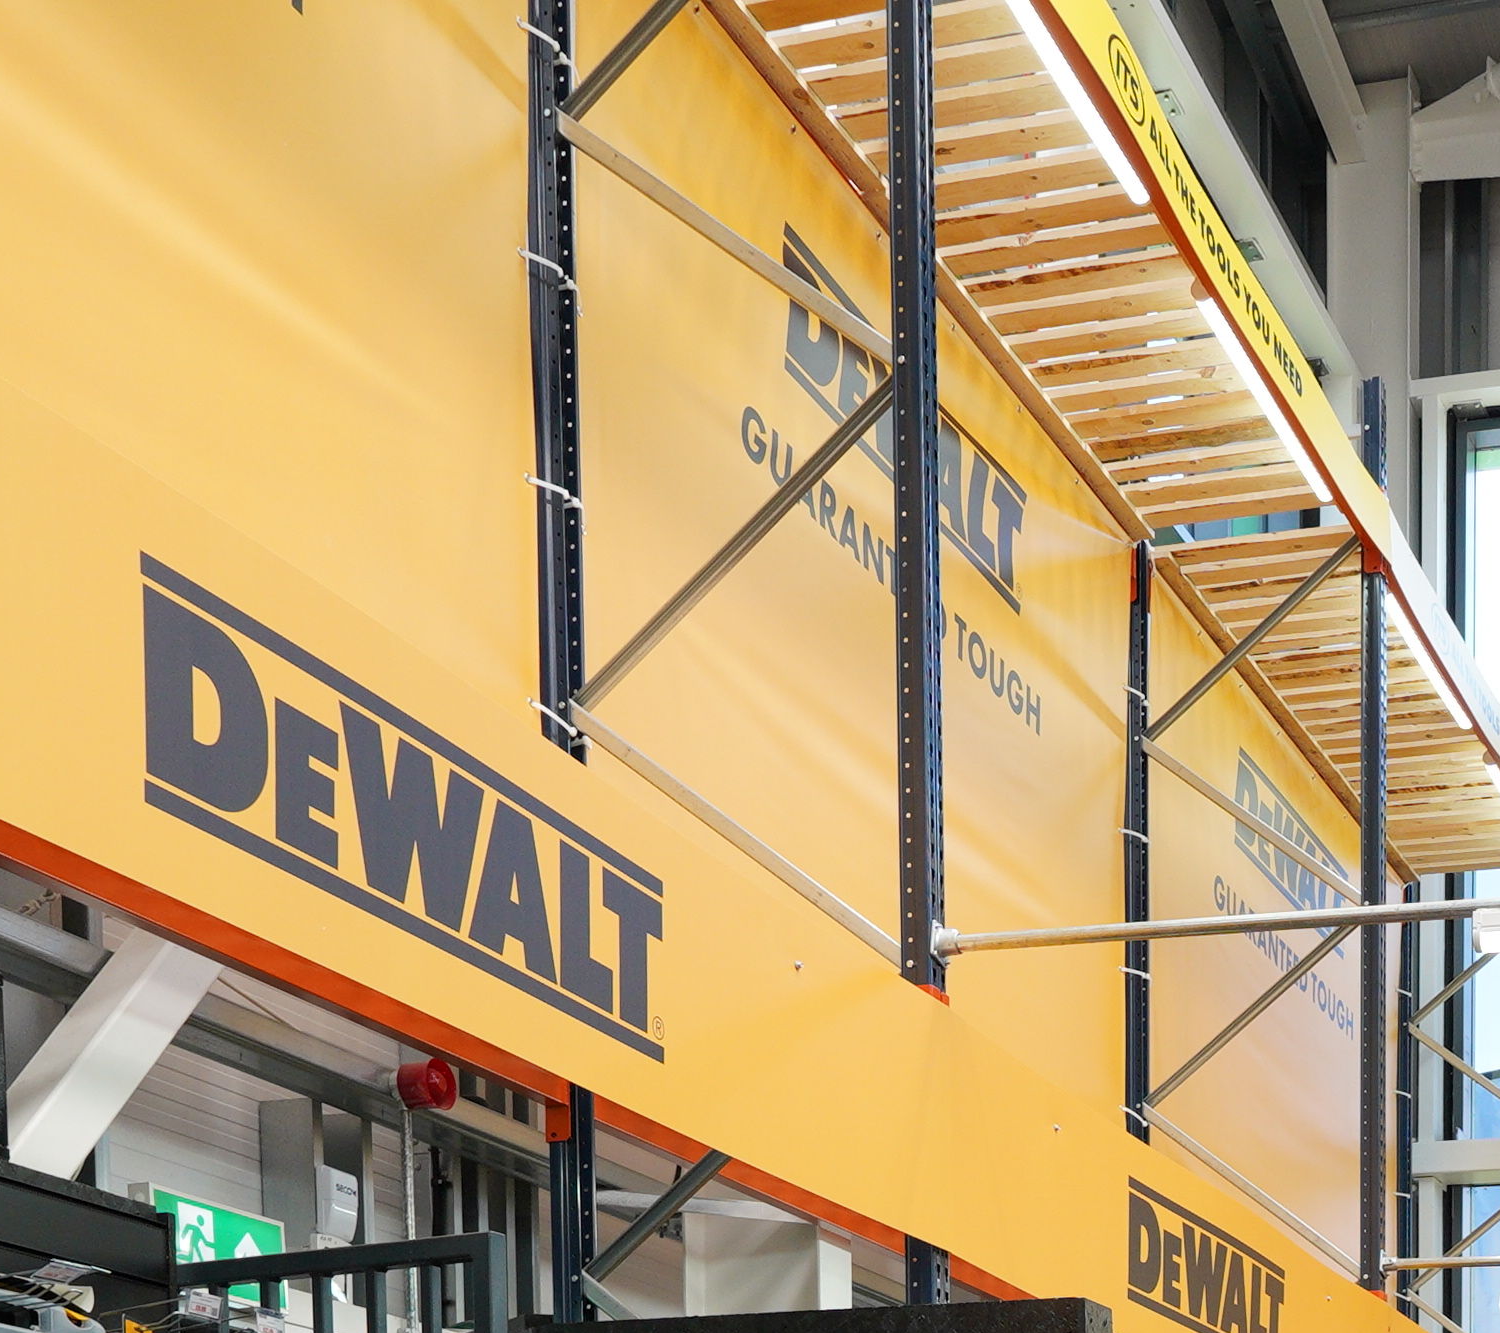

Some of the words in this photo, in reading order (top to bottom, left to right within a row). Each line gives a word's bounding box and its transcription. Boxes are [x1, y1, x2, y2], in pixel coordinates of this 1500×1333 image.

[1149, 121, 1174, 162] ALL
[1174, 167, 1201, 224] THE
[1198, 217, 1242, 289] TOOLS
[1243, 288, 1272, 347] YOU
[1273, 341, 1304, 397] NEED
[784, 298, 1025, 600] DEALT
[143, 583, 663, 1037] DEWALT
[953, 611, 1042, 735] TOUGH
[1308, 970, 1355, 1042] TOUGH
